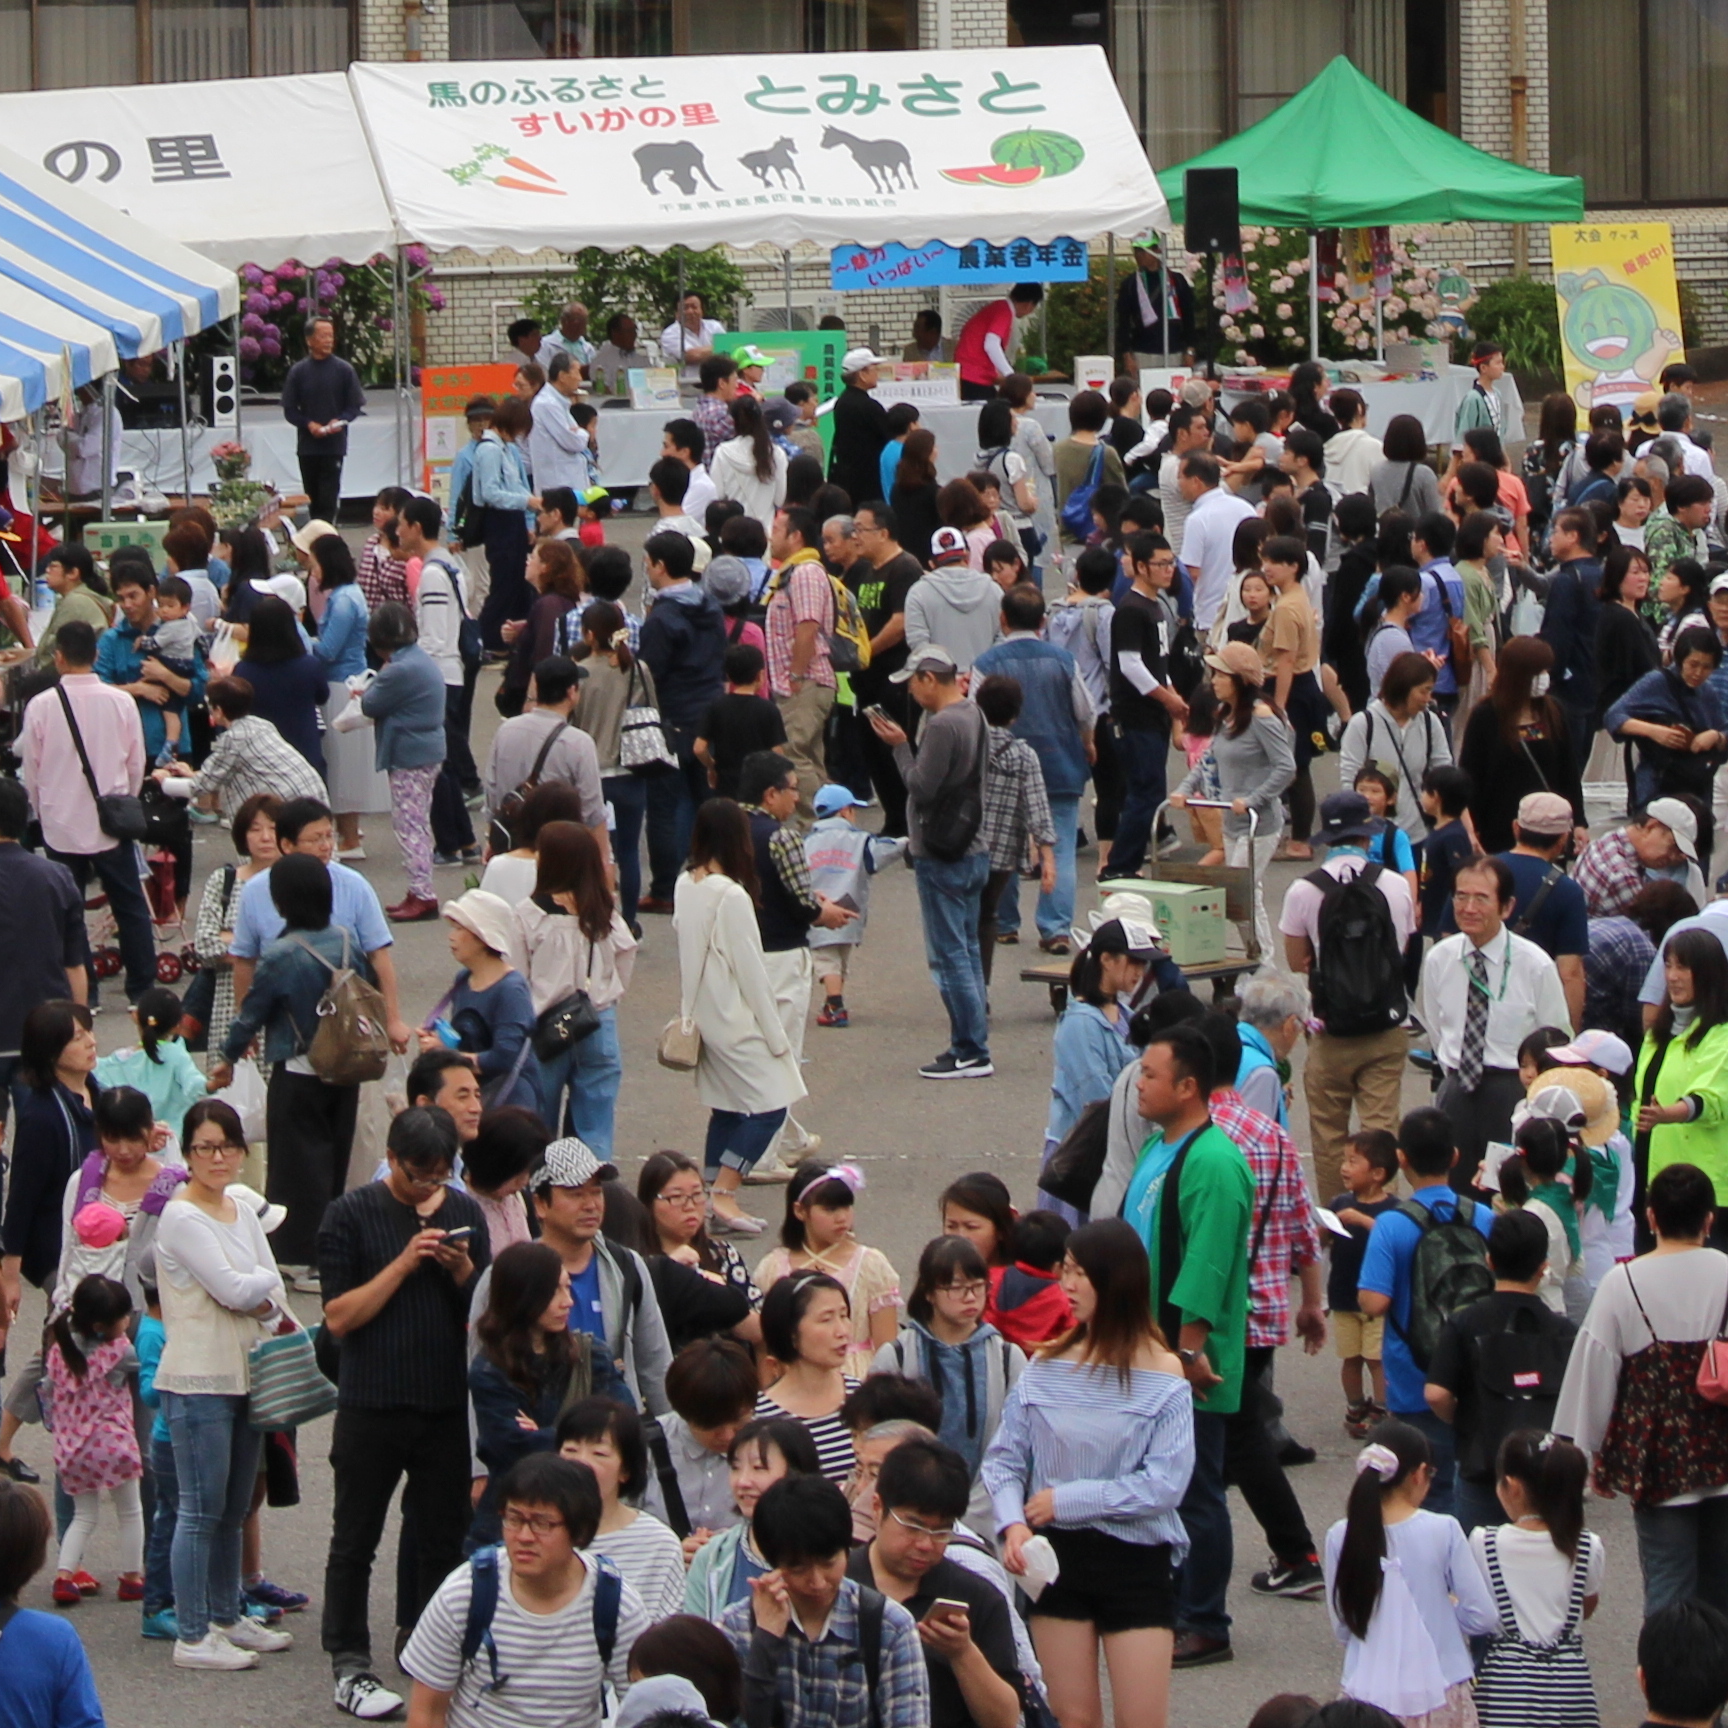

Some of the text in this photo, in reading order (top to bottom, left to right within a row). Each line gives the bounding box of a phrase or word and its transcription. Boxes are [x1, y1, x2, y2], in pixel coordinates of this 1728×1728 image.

[428, 75, 667, 108] 馬のふるさと
[744, 72, 1047, 117] とみさと
[512, 102, 720, 137] すいかの里
[959, 244, 1083, 269] 農業者年金
